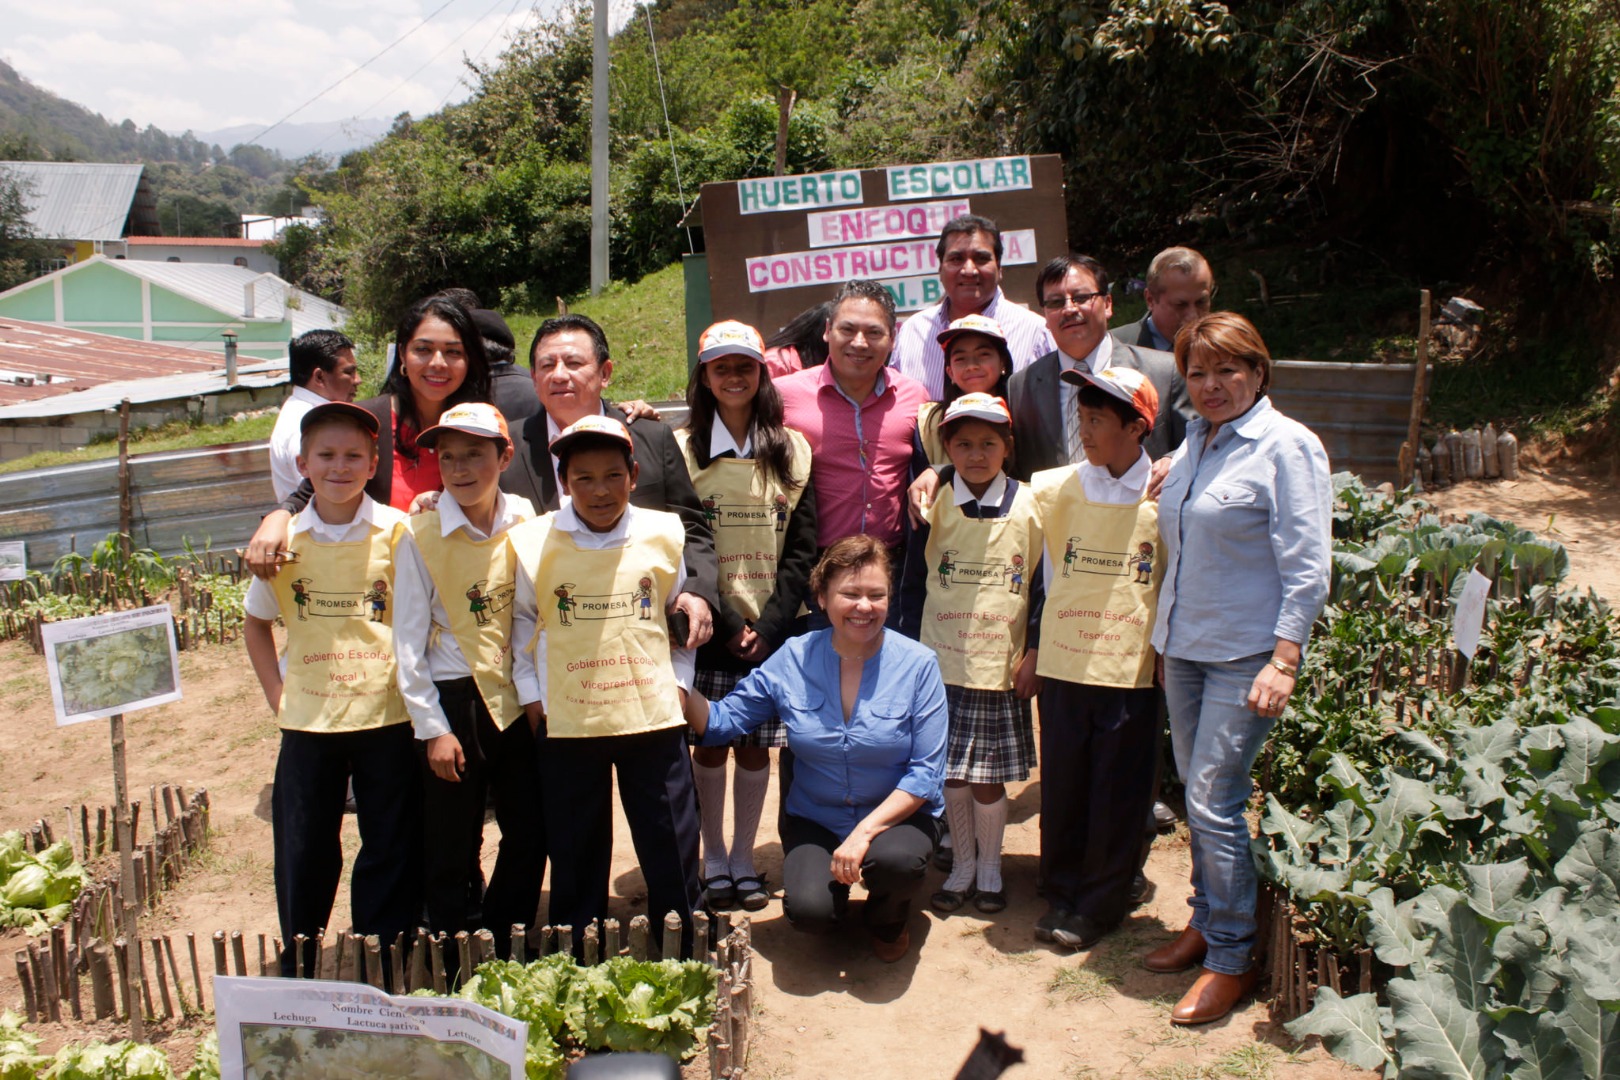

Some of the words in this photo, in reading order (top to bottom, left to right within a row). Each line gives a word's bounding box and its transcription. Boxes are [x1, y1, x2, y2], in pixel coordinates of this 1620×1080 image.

[740, 173, 860, 211] HUERTO
[891, 157, 1029, 196] ESCOLAR
[727, 511, 767, 519] PROMESA
[718, 552, 753, 564] bierno
[1081, 556, 1124, 567] PROMESA
[958, 568, 999, 578] PROMESA
[316, 599, 359, 608] PROMESA
[582, 600, 628, 610] PROMESA
[936, 610, 980, 622] Gobierno
[1057, 607, 1102, 619] Gobierno
[1104, 609, 1145, 627] Escolar
[957, 629, 1005, 640] Secretario
[1078, 629, 1121, 641] Tesorero
[303, 650, 345, 665] Gobierno
[348, 649, 391, 662] Escolar
[566, 657, 616, 672] Gobierno
[329, 671, 358, 682] Vocal
[581, 677, 655, 691] Vicepresidente
[332, 1003, 374, 1016] Nombre
[273, 1011, 317, 1024] Lechuga
[346, 1016, 388, 1030] Lactuca
[389, 1020, 420, 1032] sativa
[446, 1028, 482, 1046] Lettuce
